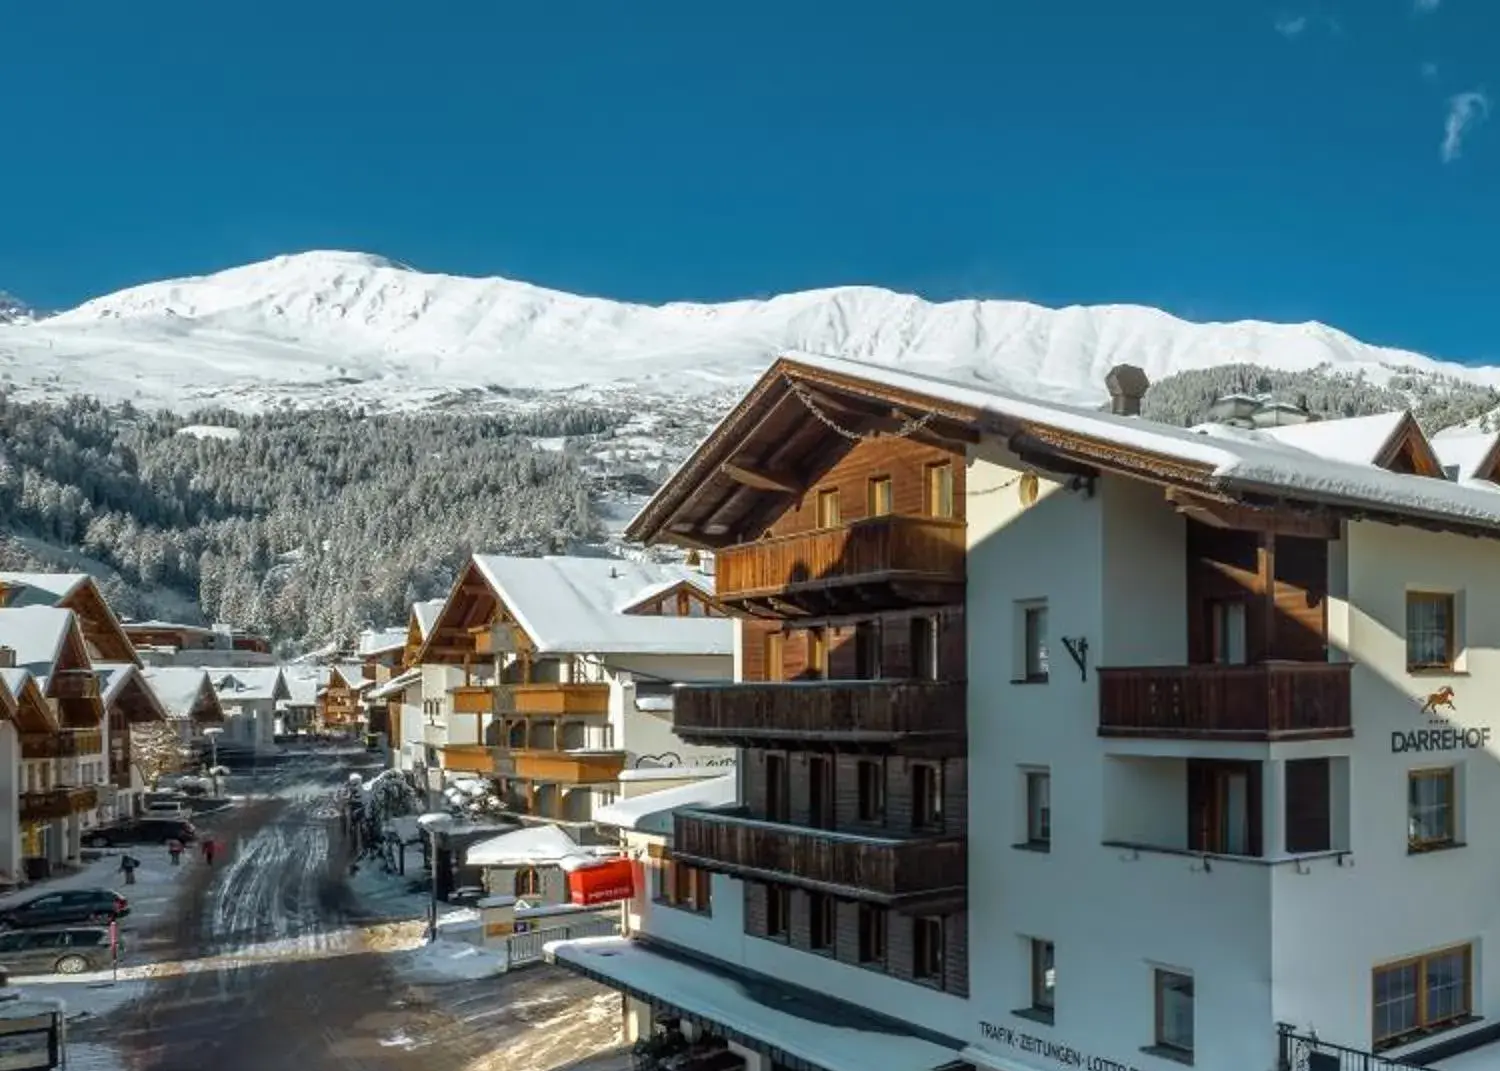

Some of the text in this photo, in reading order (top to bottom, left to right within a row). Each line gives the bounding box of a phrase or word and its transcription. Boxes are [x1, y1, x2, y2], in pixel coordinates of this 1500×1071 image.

[1391, 727, 1491, 753] DARREHOF
[979, 1021, 1014, 1045] TRAFIK
[1019, 1033, 1081, 1068] ZEITUNGEN
